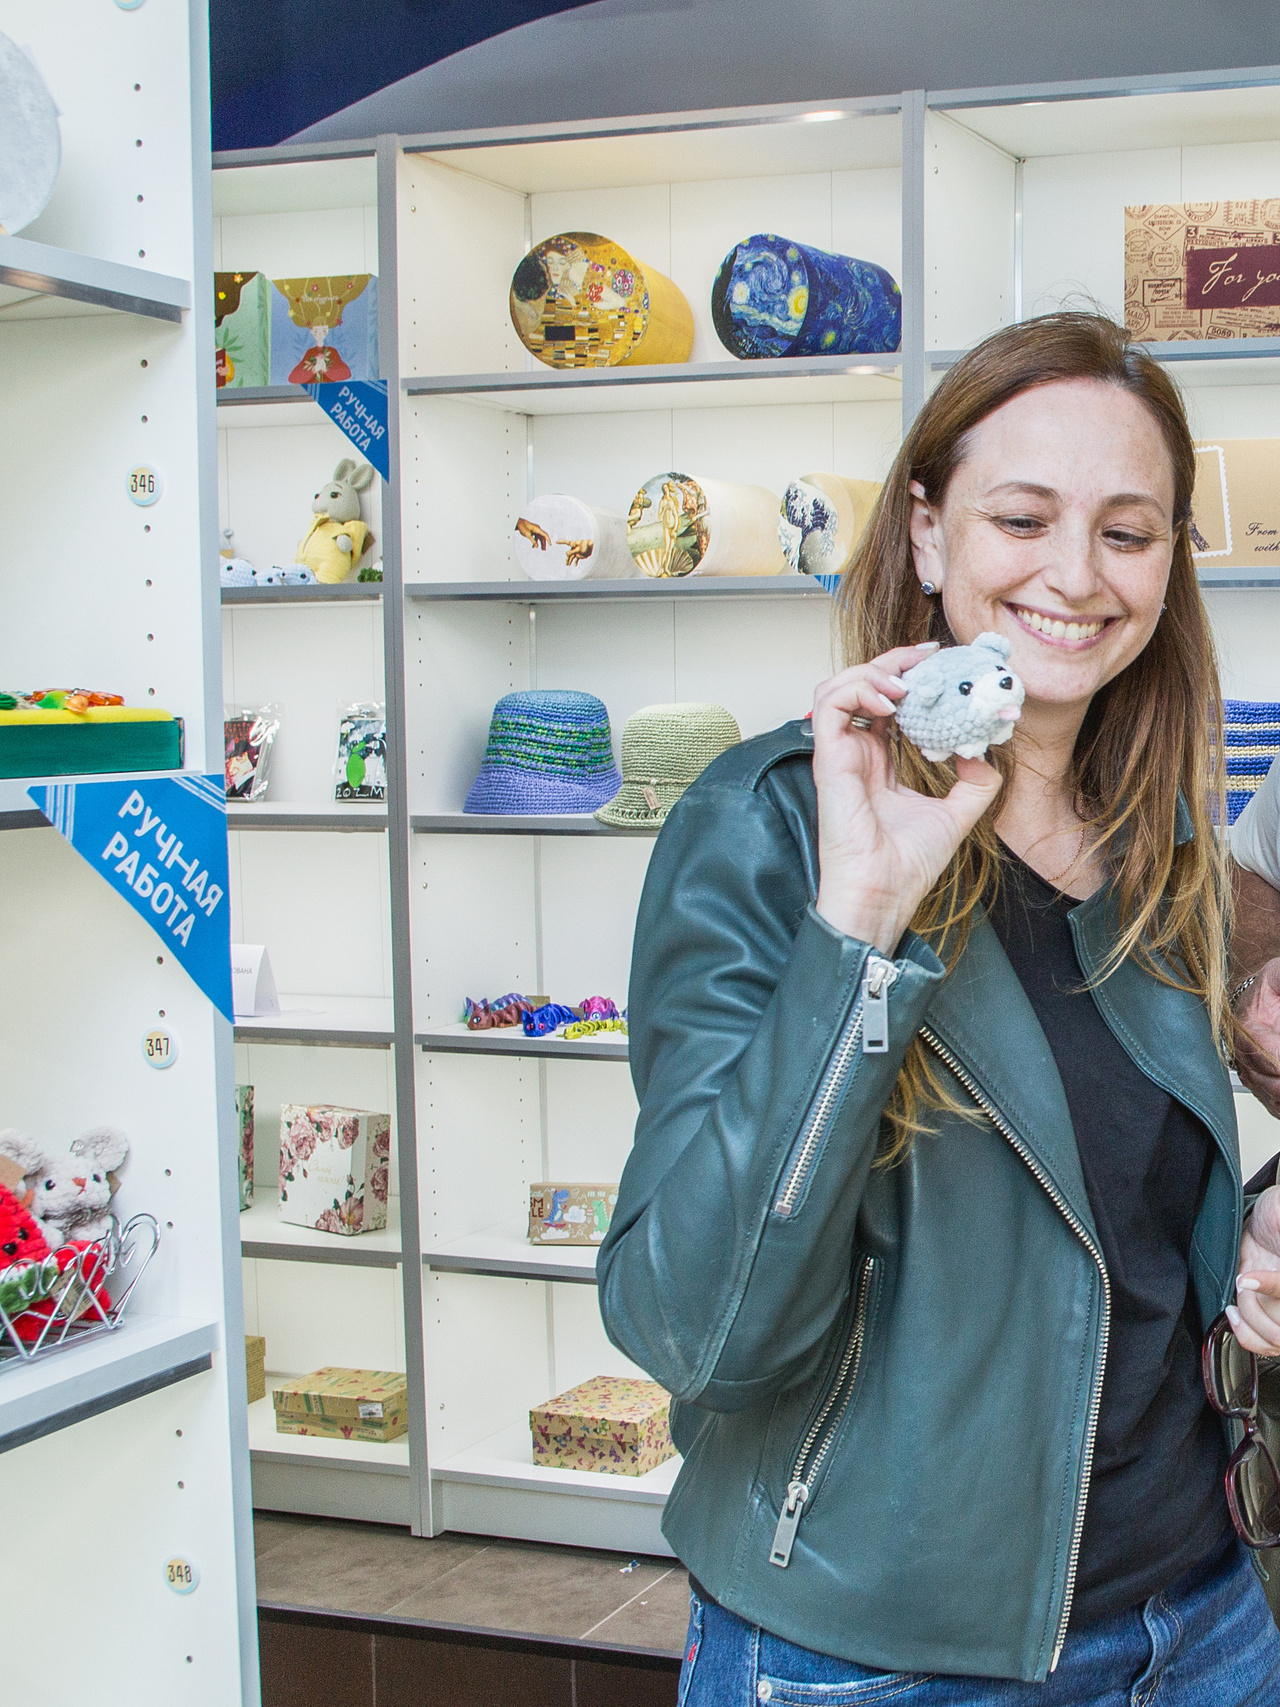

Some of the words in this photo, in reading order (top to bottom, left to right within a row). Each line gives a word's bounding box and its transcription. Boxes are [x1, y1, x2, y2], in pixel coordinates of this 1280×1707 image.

[1187, 226, 1197, 238] 3
[1201, 252, 1247, 295] For
[329, 402, 371, 452] РАБОТА
[337, 385, 386, 440] РУЧНАЯ
[131, 474, 155, 493] 346
[1245, 522, 1279, 536] From
[117, 789, 225, 917] РУЧНАЯ
[101, 830, 196, 948] РАБОТА
[146, 1037, 169, 1056] 347
[167, 1564, 192, 1583] 348
